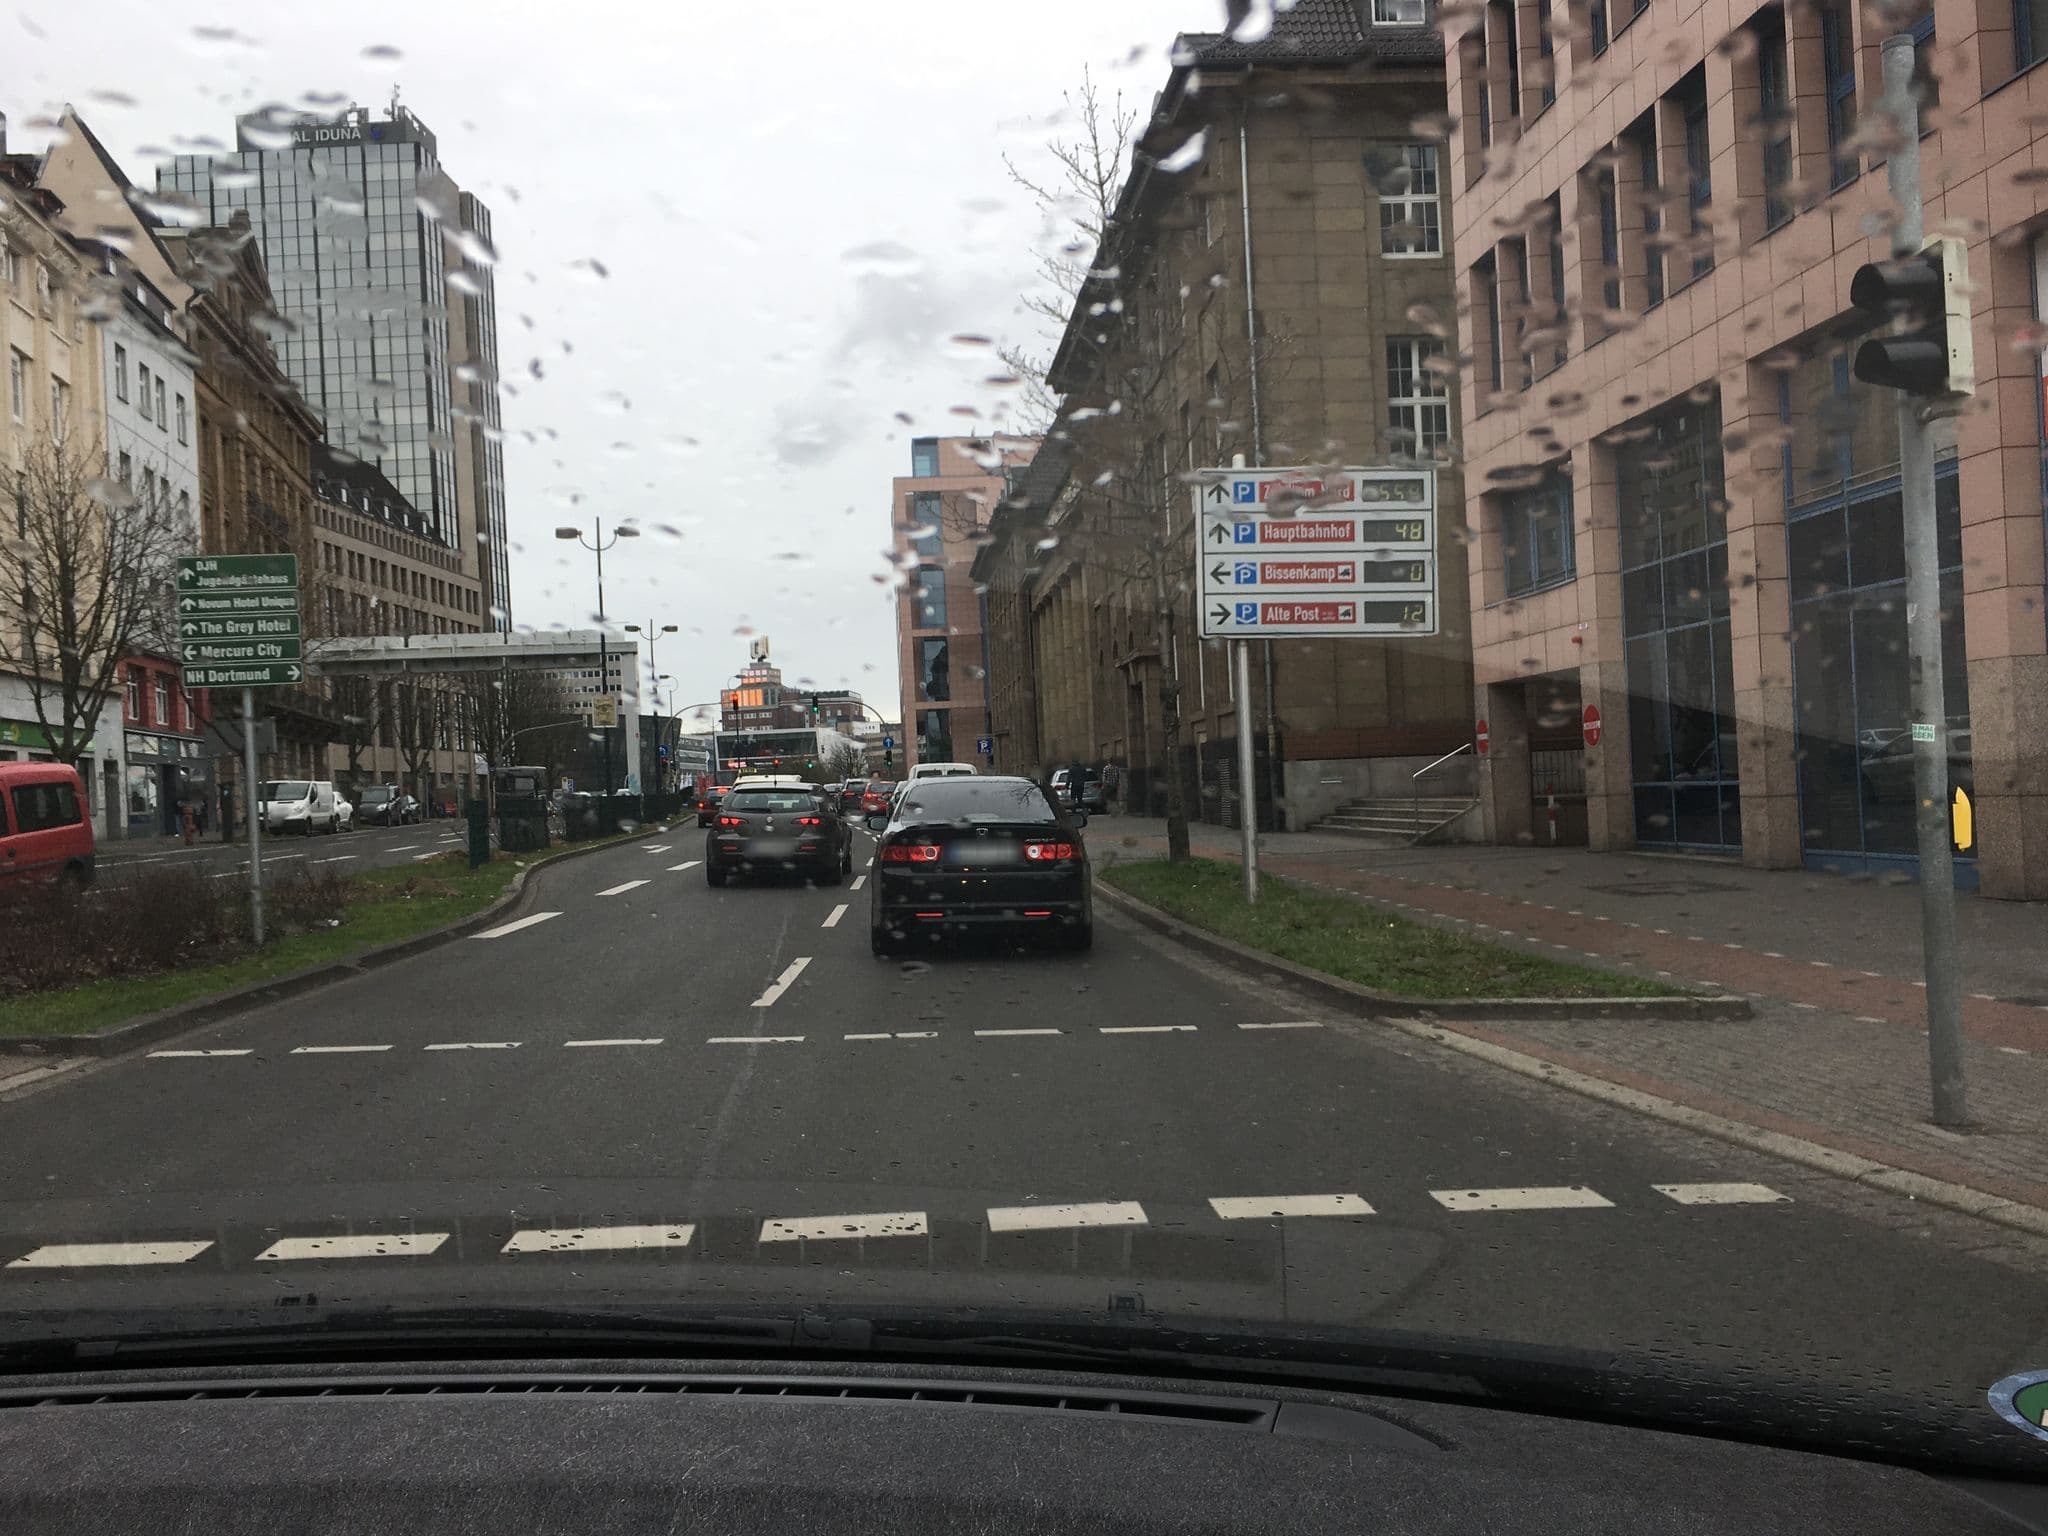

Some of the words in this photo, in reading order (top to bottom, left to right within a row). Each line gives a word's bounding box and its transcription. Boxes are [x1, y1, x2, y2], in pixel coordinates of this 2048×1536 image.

[315, 127, 361, 142] IDUNA
[1264, 523, 1351, 542] Hauptbahnhof
[1395, 523, 1422, 540] 48
[196, 561, 217, 571] DJH
[1265, 564, 1335, 582] Bissenkamp
[1410, 563, 1422, 581] 0
[196, 575, 288, 588] Jugendgätehaus
[233, 597, 260, 608] Hotel
[1267, 606, 1290, 621] Alte
[1294, 605, 1319, 620] Post
[1404, 604, 1423, 622] 12
[200, 621, 223, 634] The
[226, 620, 254, 635] Grey
[257, 618, 291, 632] Hotel
[200, 645, 254, 658] Mercure
[257, 643, 283, 657] City
[186, 671, 205, 683] NH
[208, 668, 270, 682] Dortmund
